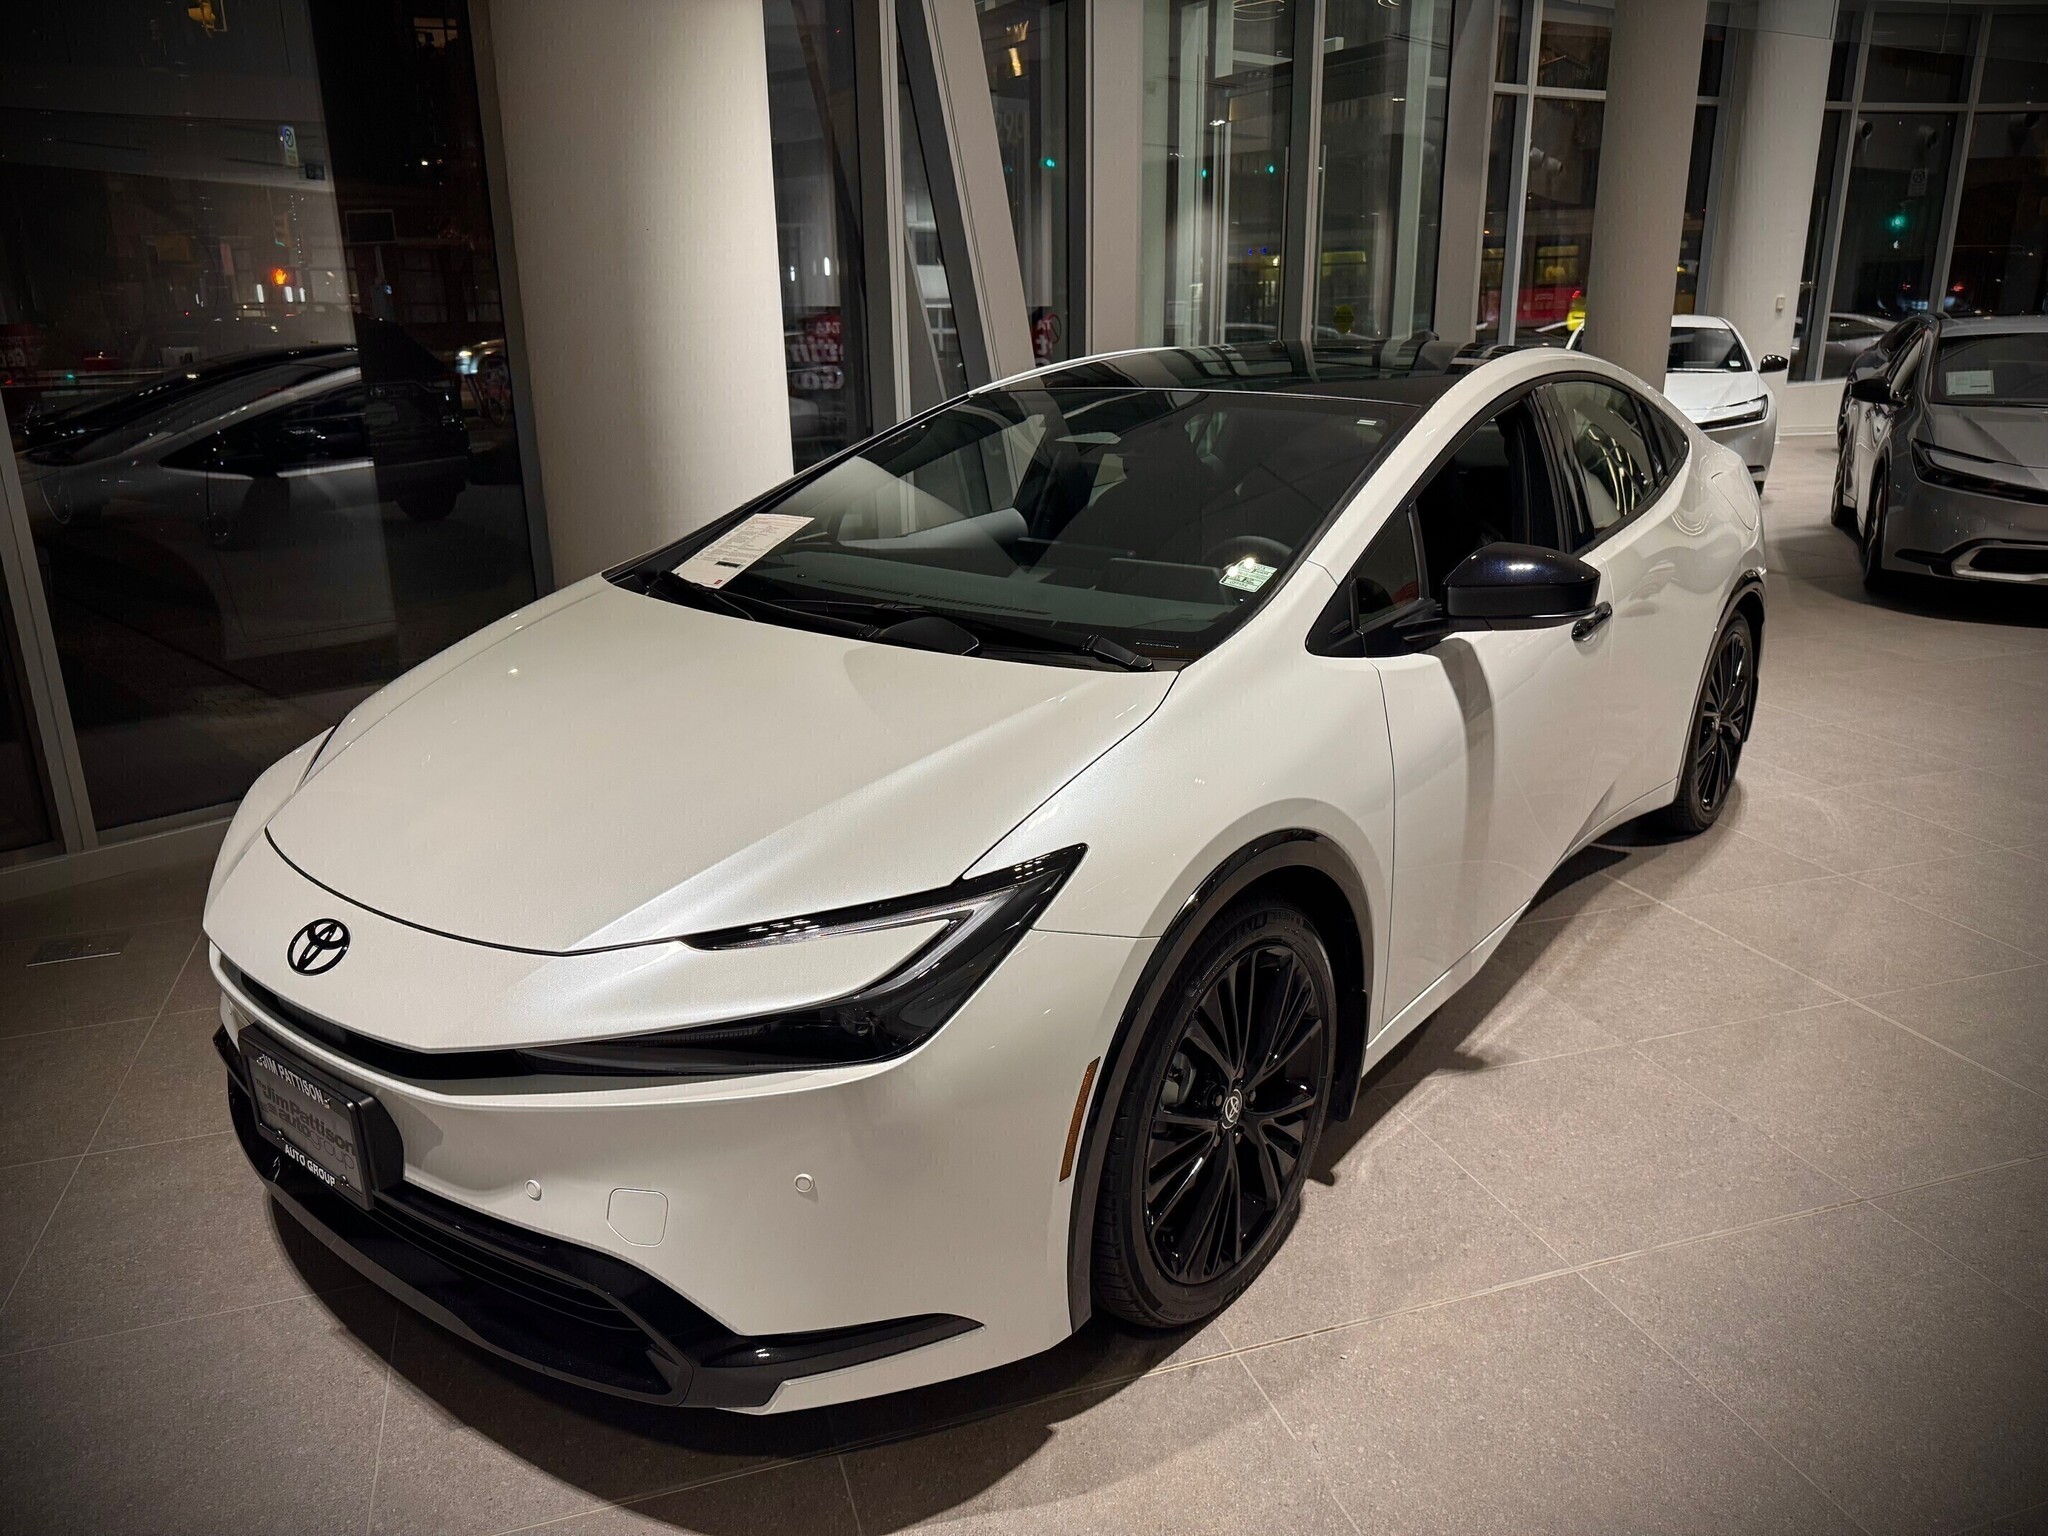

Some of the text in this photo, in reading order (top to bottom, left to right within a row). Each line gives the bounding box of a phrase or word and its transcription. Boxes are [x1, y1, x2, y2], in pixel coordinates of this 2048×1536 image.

[262, 1054, 324, 1105] JIM PATTISON
[285, 1144, 335, 1187] AUTO GROUP
